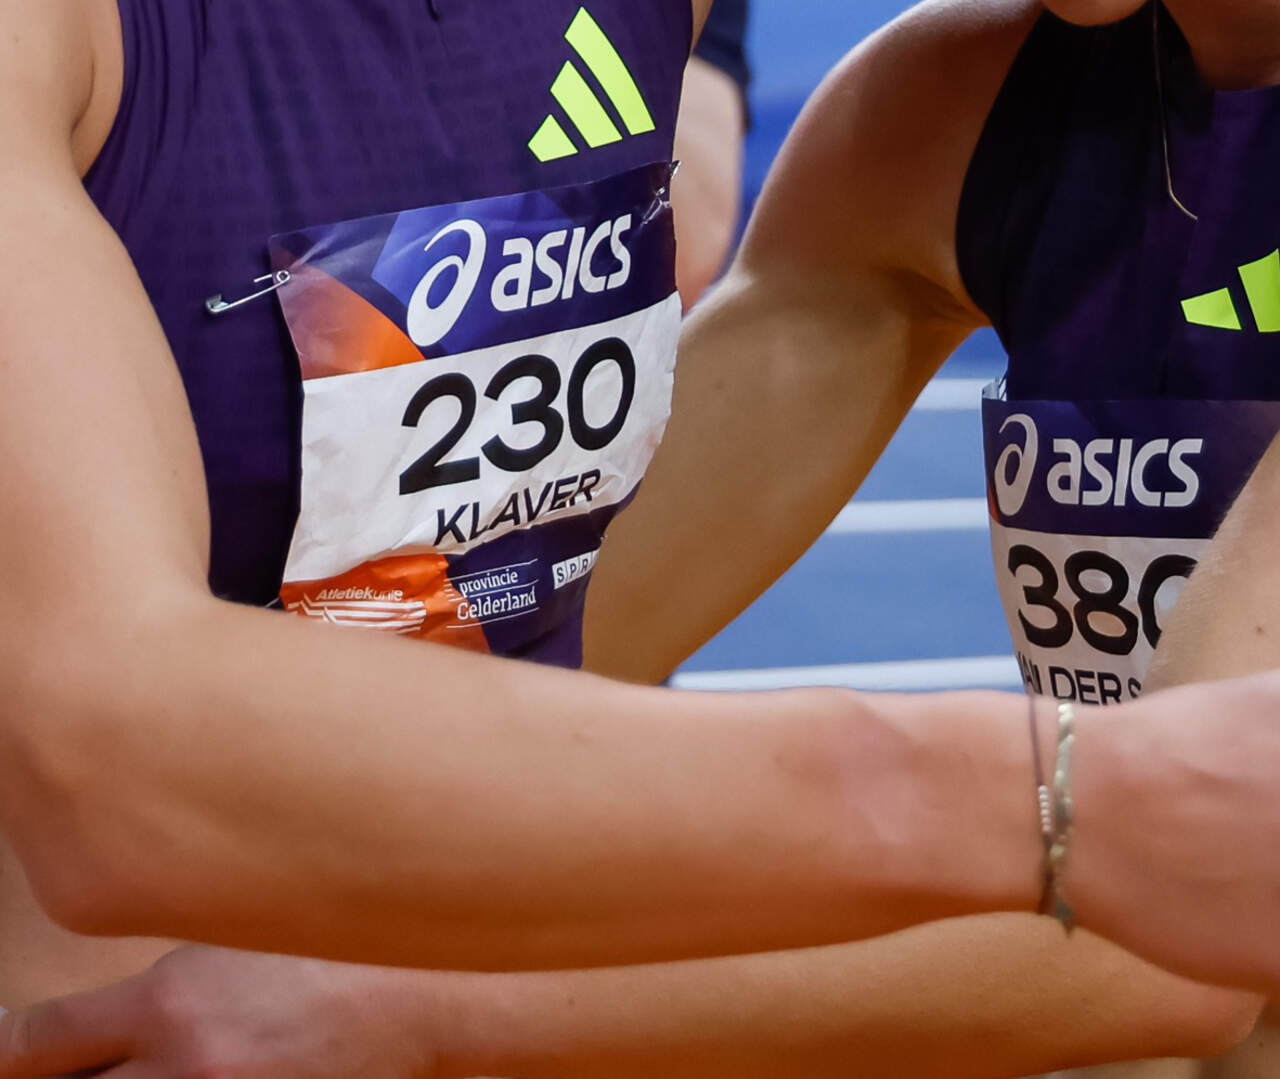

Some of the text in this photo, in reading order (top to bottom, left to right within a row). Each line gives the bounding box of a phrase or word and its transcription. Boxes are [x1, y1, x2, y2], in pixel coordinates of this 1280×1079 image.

[489, 213, 632, 313] asics
[398, 336, 636, 497] 230
[1046, 438, 1203, 507] asics
[433, 468, 603, 547] KLAVER
[458, 567, 518, 597] provincie
[556, 554, 597, 583] SPR
[456, 585, 536, 621] Gelderland
[1048, 665, 1122, 706] DER
